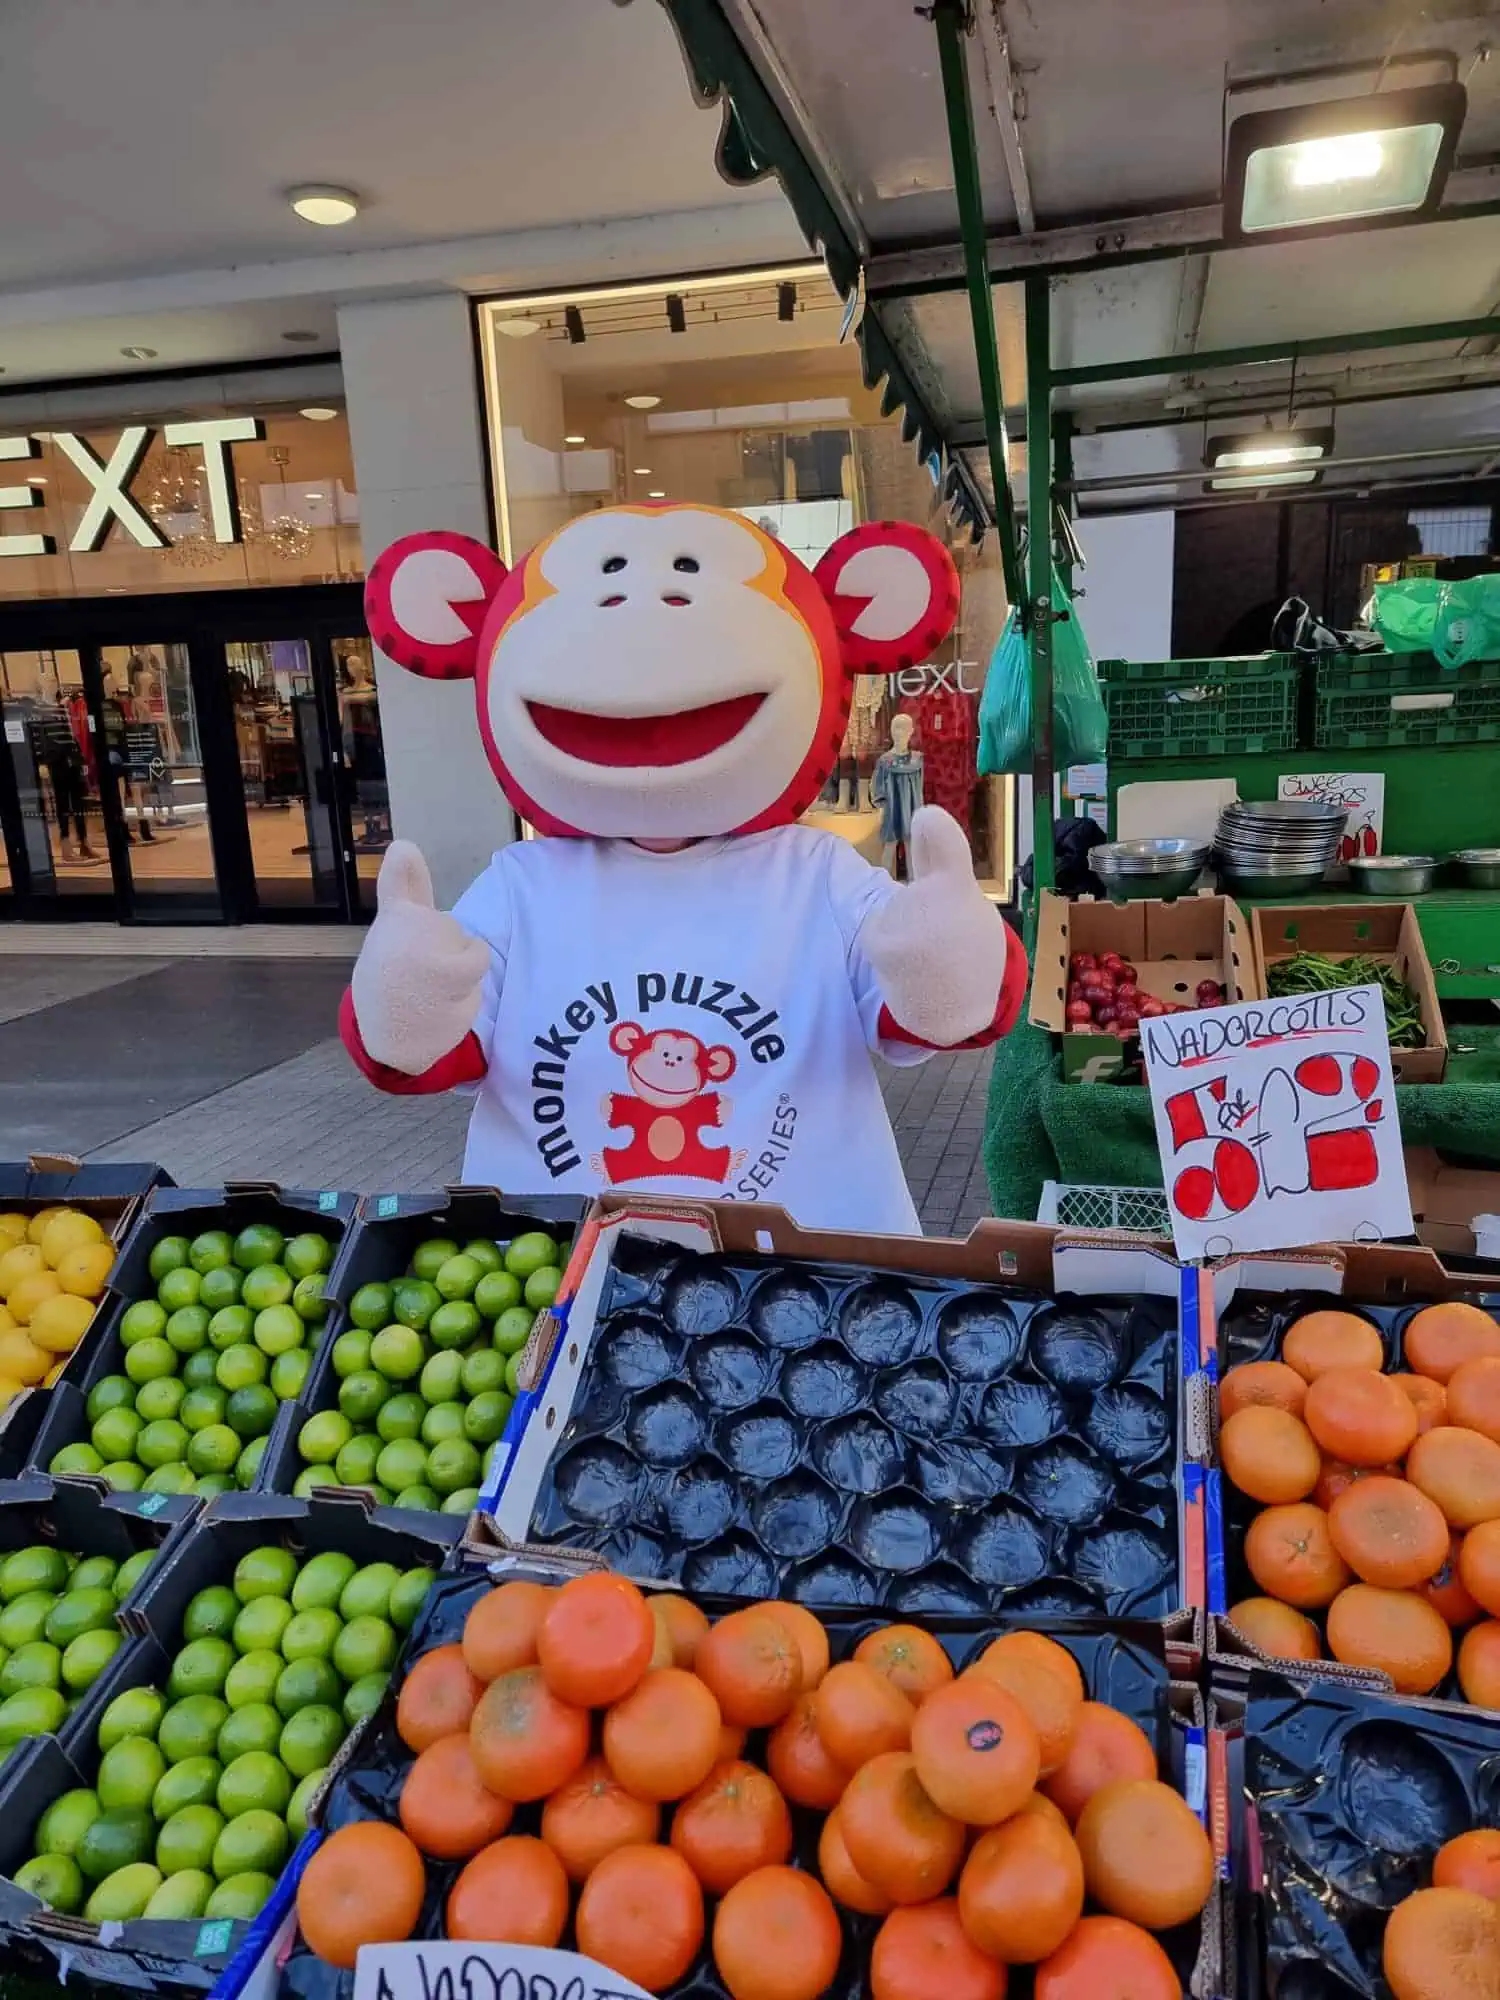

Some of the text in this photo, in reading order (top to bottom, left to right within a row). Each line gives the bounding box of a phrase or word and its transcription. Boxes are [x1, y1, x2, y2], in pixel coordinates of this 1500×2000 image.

[532, 972, 785, 1178] monkey puzzle
[1148, 989, 1370, 1068] NADORCOTTS
